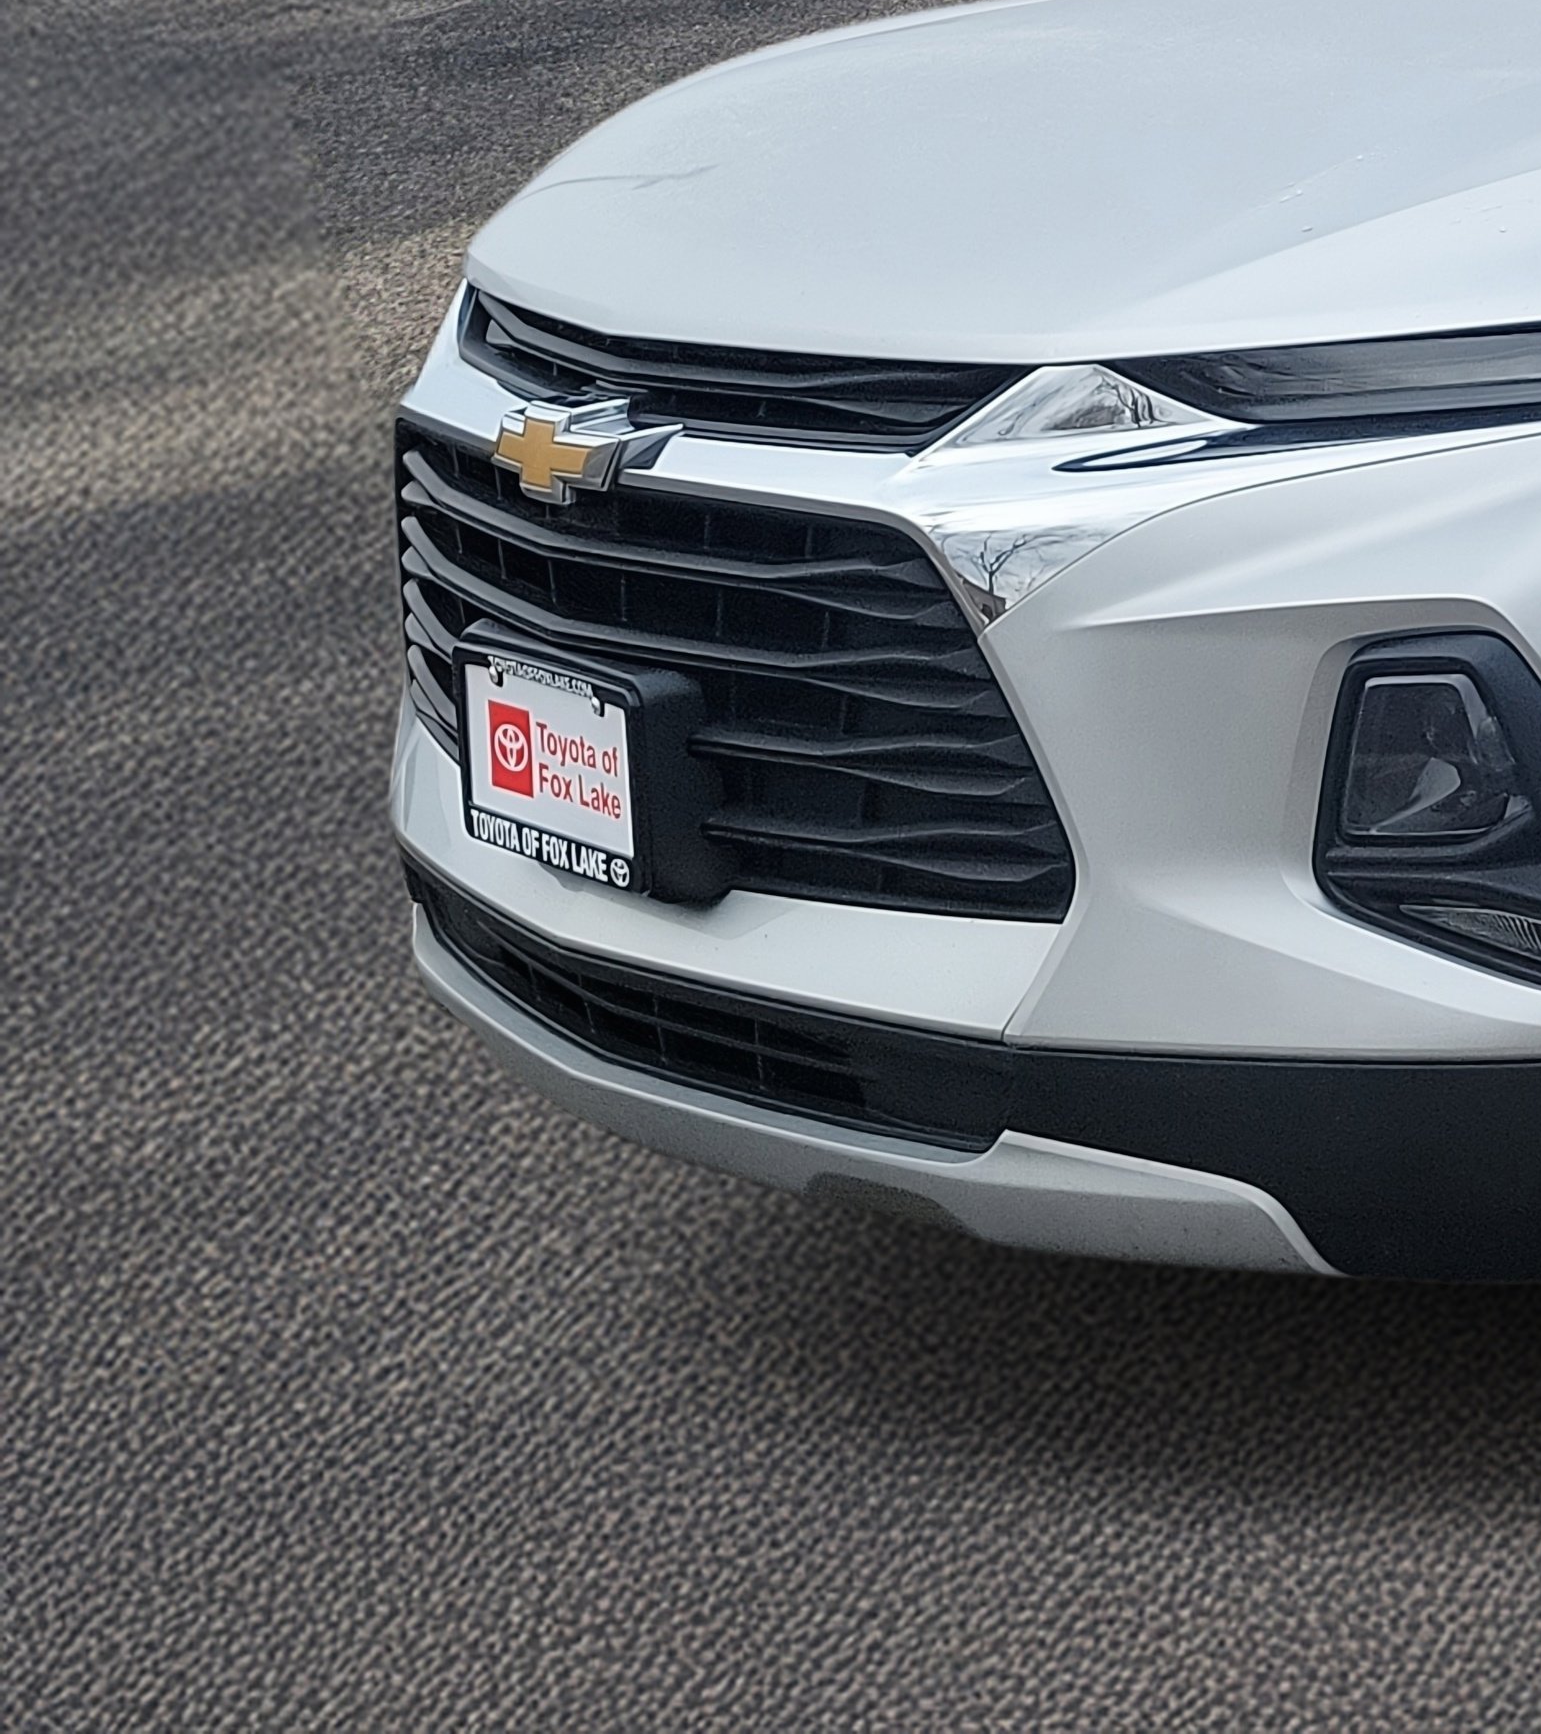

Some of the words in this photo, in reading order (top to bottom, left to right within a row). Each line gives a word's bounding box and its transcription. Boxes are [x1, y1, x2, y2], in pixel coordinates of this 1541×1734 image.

[535, 721, 597, 769] Toyota
[602, 746, 618, 777] of
[538, 762, 574, 803] Fox
[578, 773, 621, 819] Lake
[470, 808, 521, 853] TOYOTA
[521, 826, 540, 858] OF
[541, 832, 570, 869] FOX
[570, 842, 609, 882] LAKE
